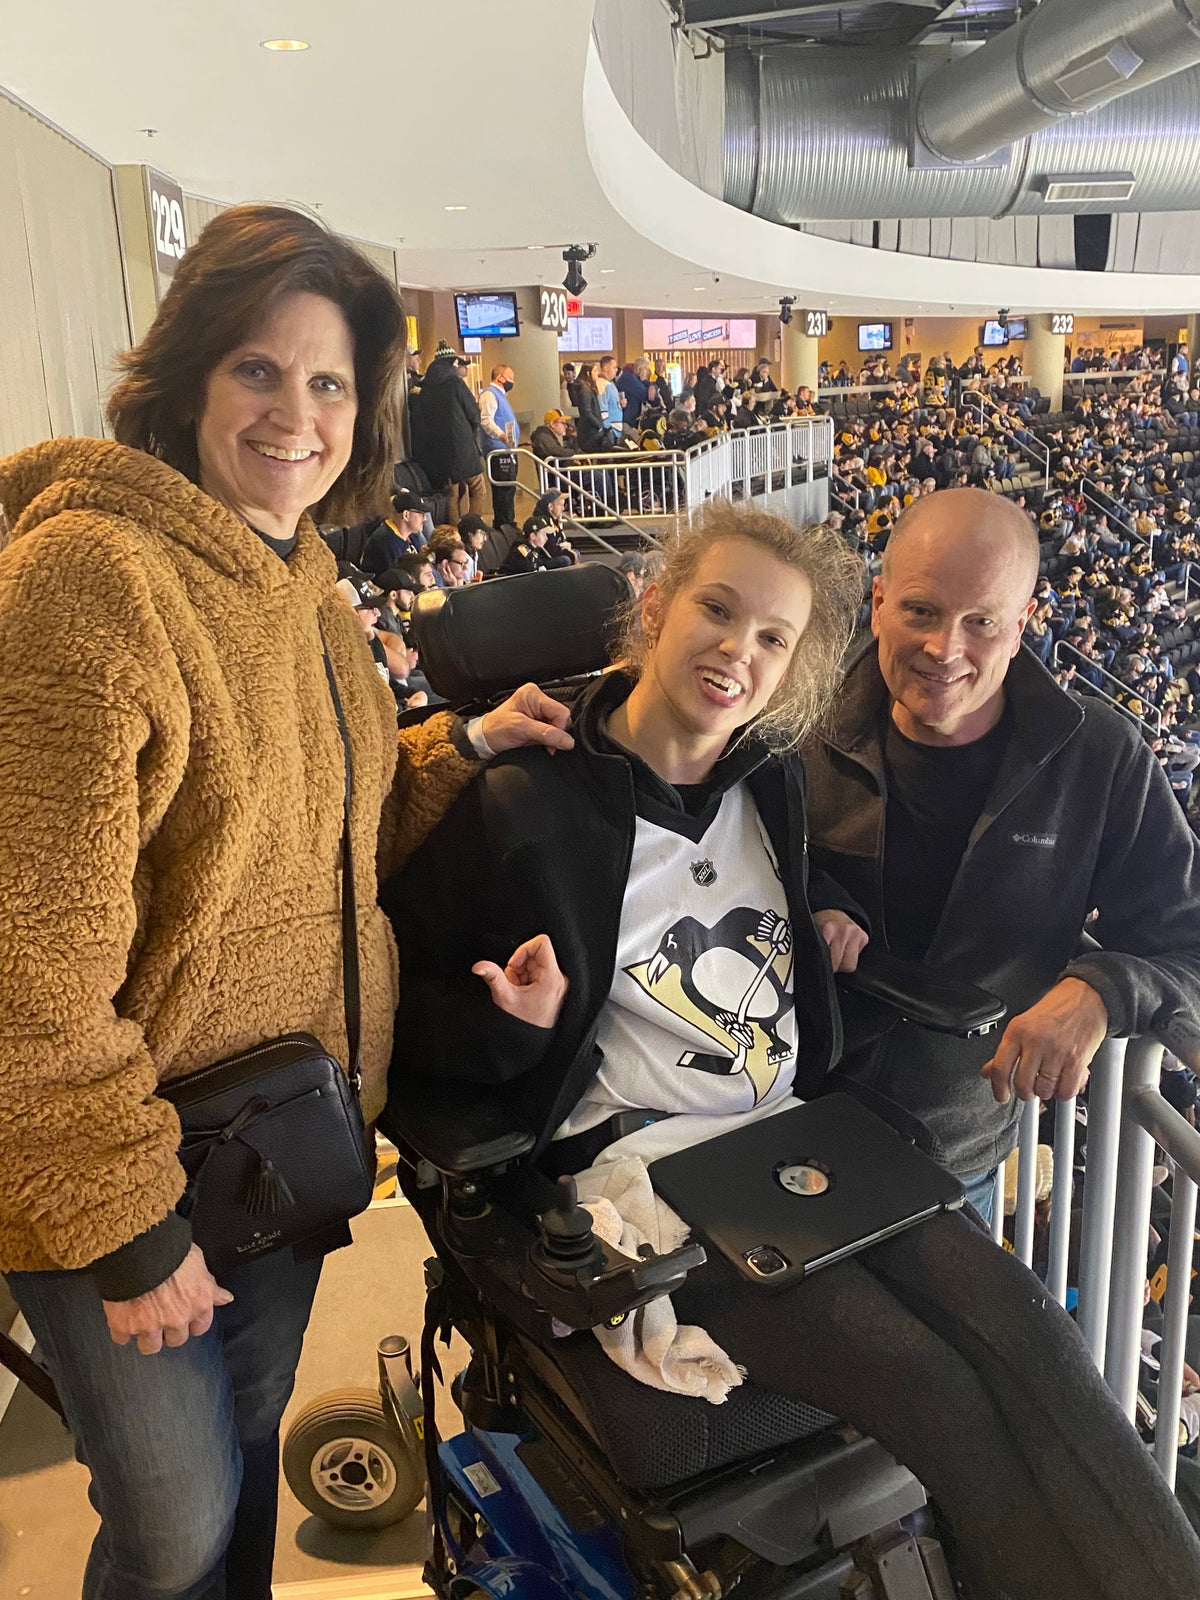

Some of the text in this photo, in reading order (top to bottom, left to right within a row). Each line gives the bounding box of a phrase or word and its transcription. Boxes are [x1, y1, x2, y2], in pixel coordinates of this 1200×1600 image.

[152, 190, 186, 259] 229
[541, 291, 567, 328] 230
[807, 312, 826, 336] 231
[1052, 314, 1074, 334] 232
[1021, 833, 1055, 845] Columbia
[698, 865, 710, 881] NHL
